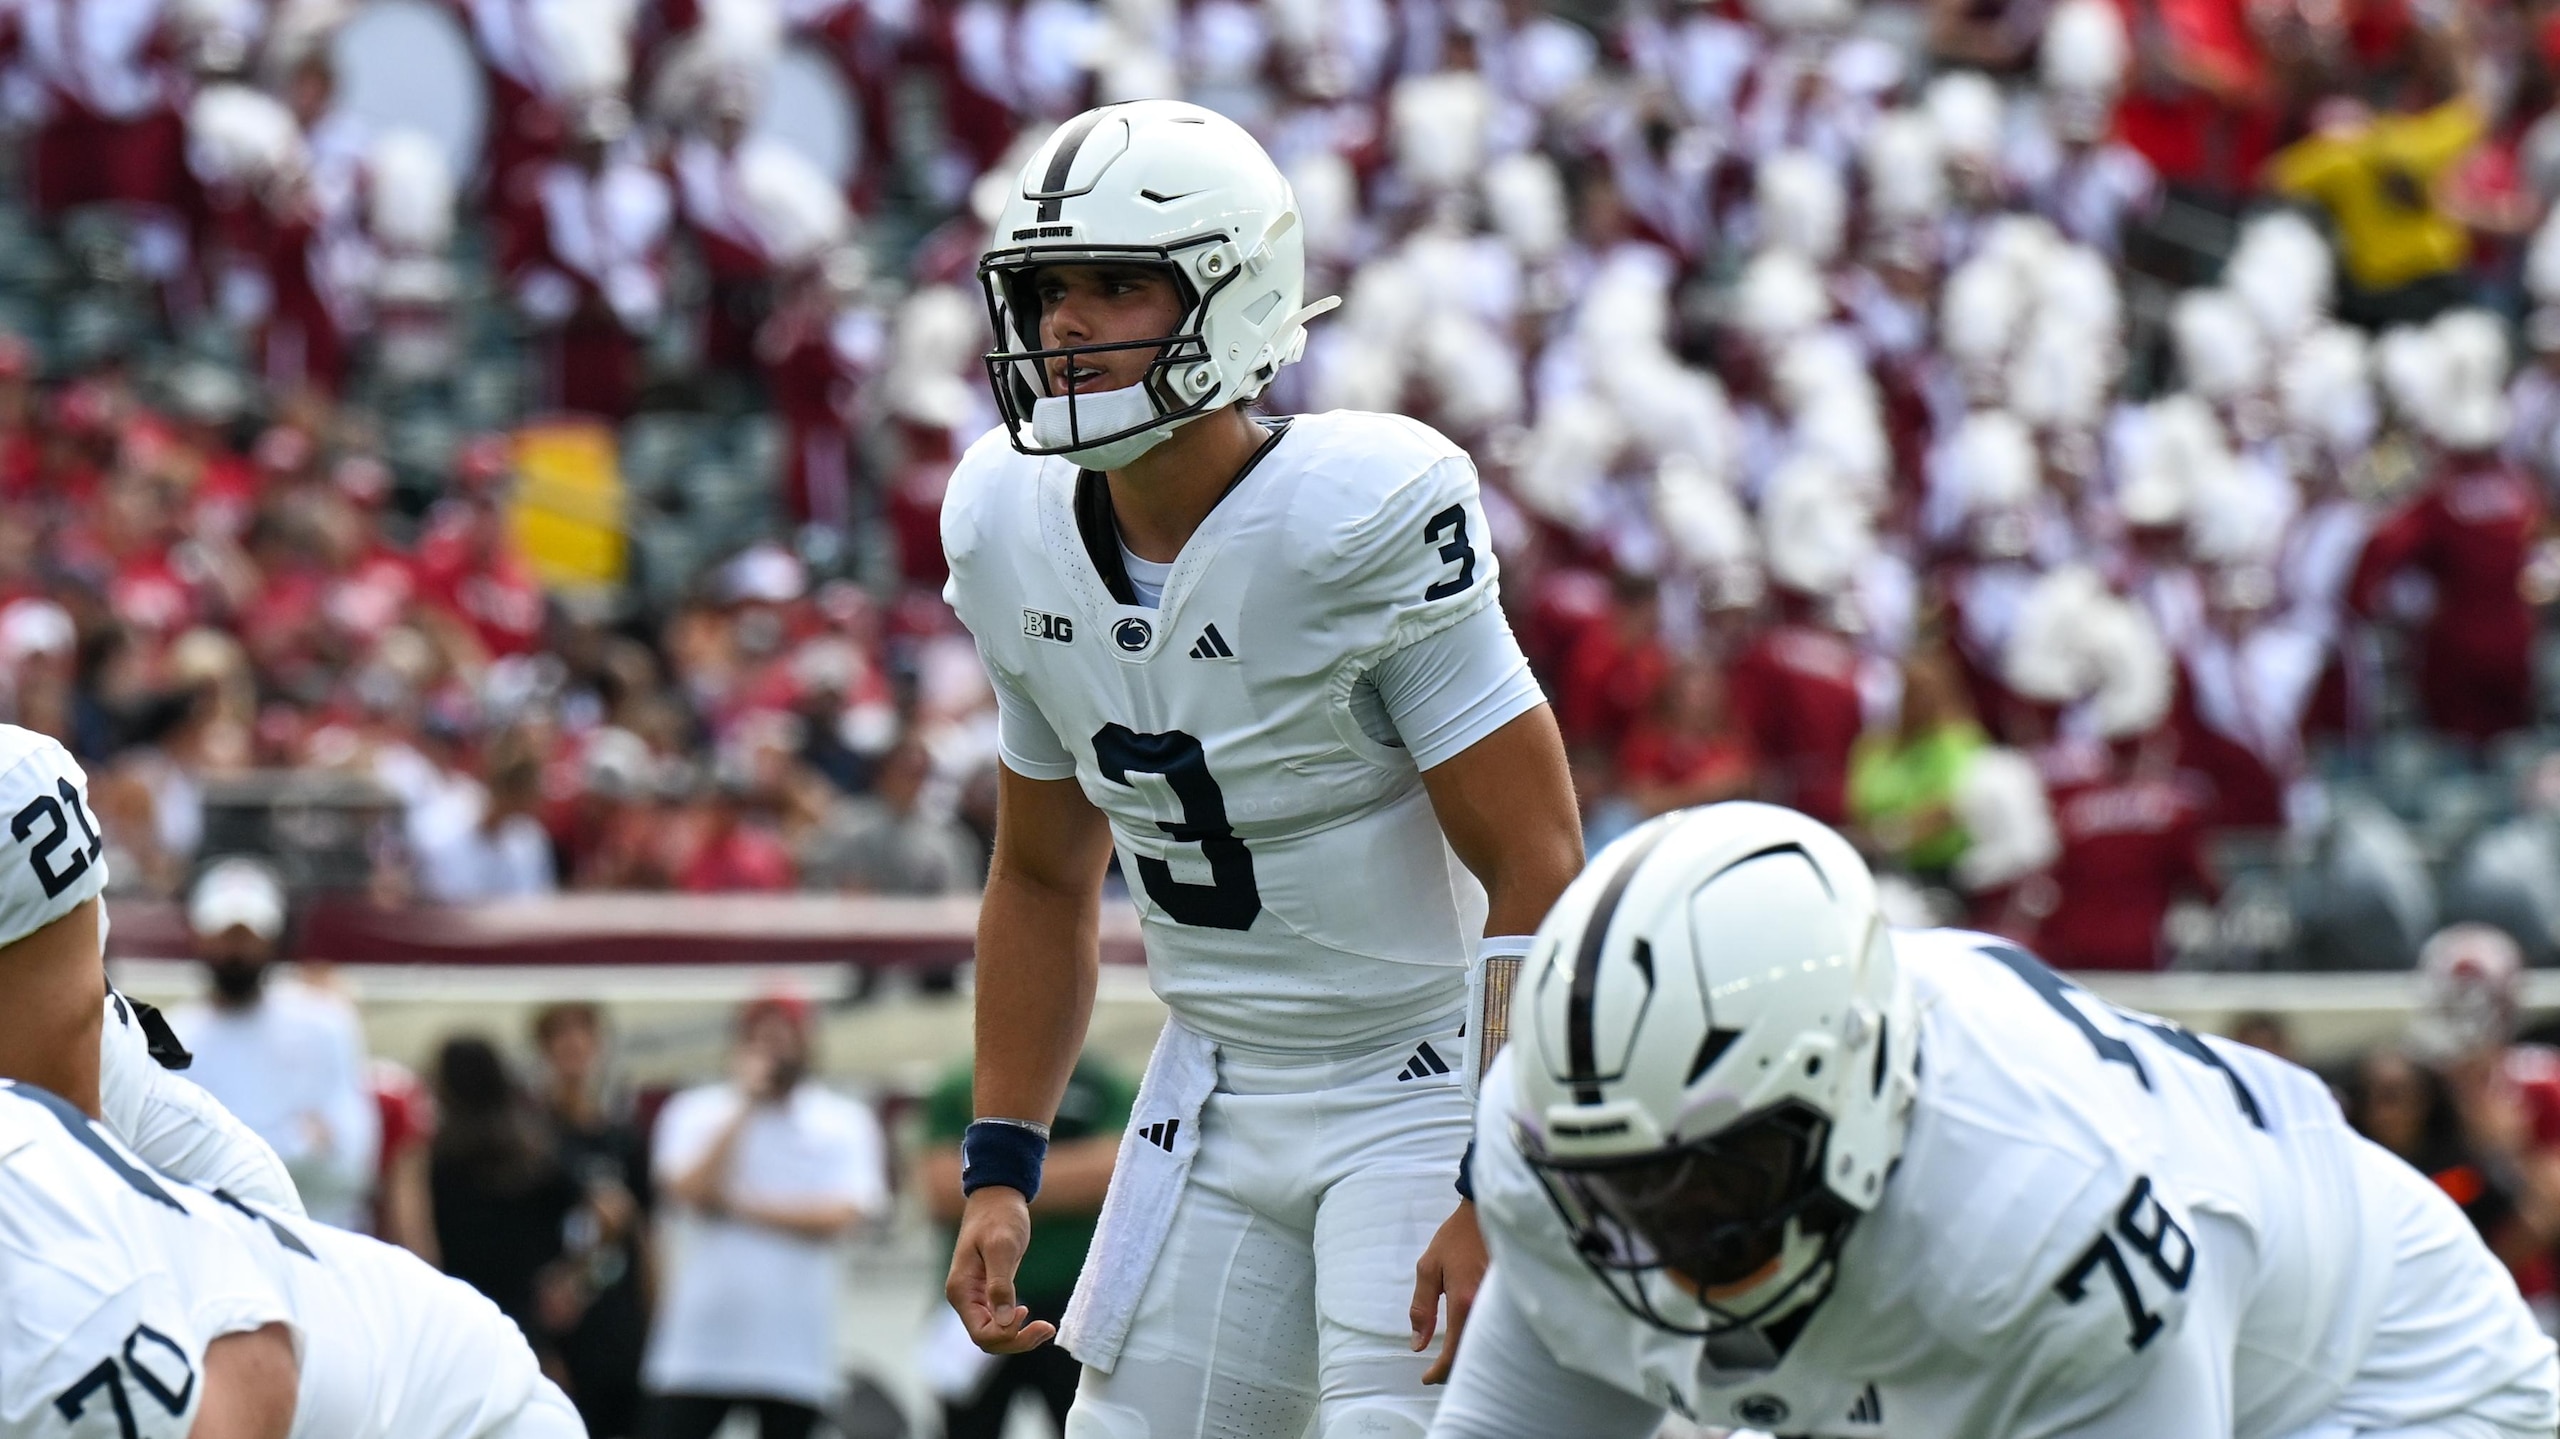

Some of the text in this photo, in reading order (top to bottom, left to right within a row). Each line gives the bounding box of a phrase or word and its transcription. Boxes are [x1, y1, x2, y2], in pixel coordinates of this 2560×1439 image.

[1039, 226, 1073, 238] STATE
[1425, 504, 1475, 602] 3
[11, 776, 101, 900] 21
[1091, 722, 1262, 931] 3
[2053, 1175, 2195, 1352] 78
[53, 1324, 194, 1439] 70
